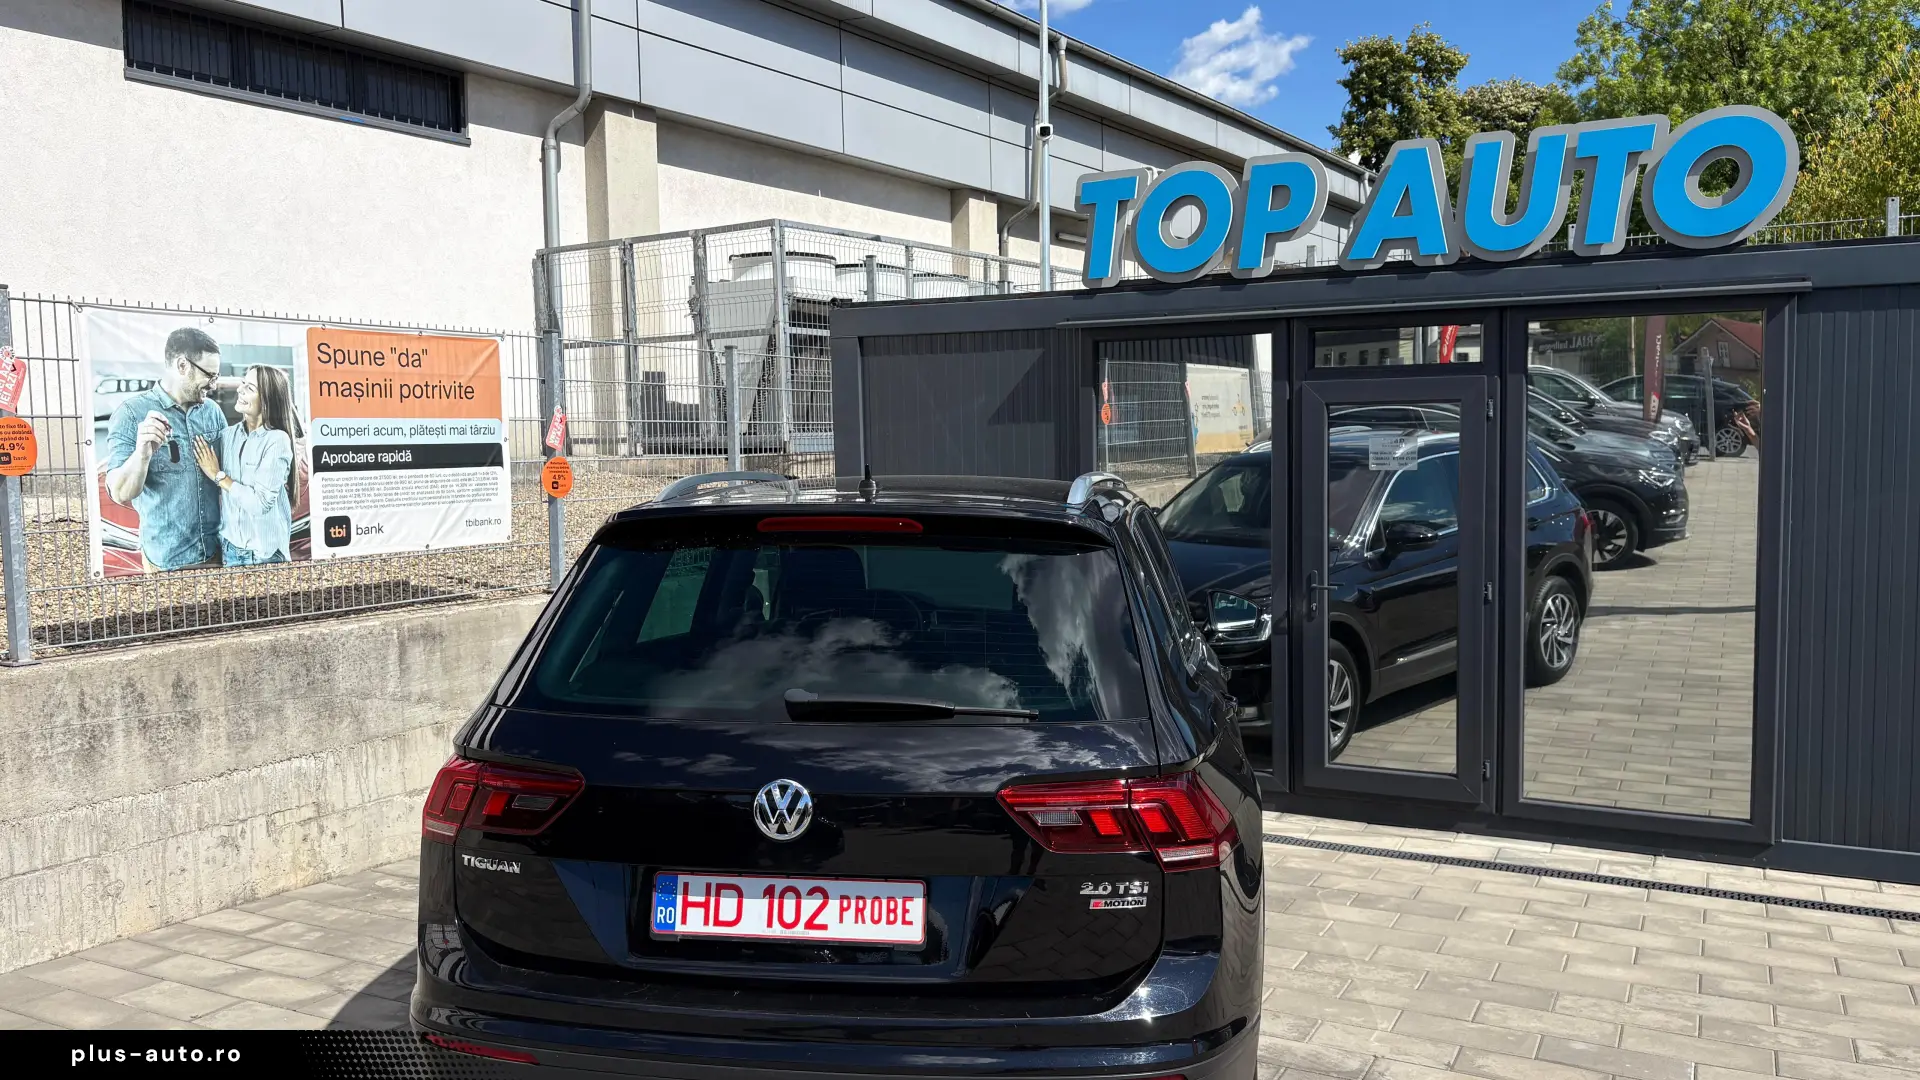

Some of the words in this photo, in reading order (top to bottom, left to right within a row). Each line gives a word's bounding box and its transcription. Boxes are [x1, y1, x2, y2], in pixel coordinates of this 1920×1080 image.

[1077, 155, 1328, 287] TOP
[1340, 106, 1798, 270] AUTO
[317, 342, 386, 369] Spune
[390, 346, 428, 368] "da"
[319, 377, 393, 404] mașinii
[400, 379, 475, 403] potrivite
[320, 423, 370, 439] Cumperi
[373, 424, 407, 438] acum,
[409, 423, 447, 439] plătești
[449, 424, 468, 436] mai
[470, 424, 496, 436] târziu
[0, 442, 26, 451] 4.9%
[320, 450, 376, 466] Aprobare
[378, 449, 412, 464] rapidă
[329, 524, 347, 538] tbi
[356, 522, 384, 535] bank
[465, 517, 502, 528] tbibank.ro
[754, 779, 812, 840] VW
[461, 854, 521, 874] TIGUAN
[1080, 882, 1112, 895] 2.0
[656, 906, 675, 924] RO
[680, 881, 744, 927] HD
[762, 884, 829, 931] 102
[838, 894, 915, 926] PROBE
